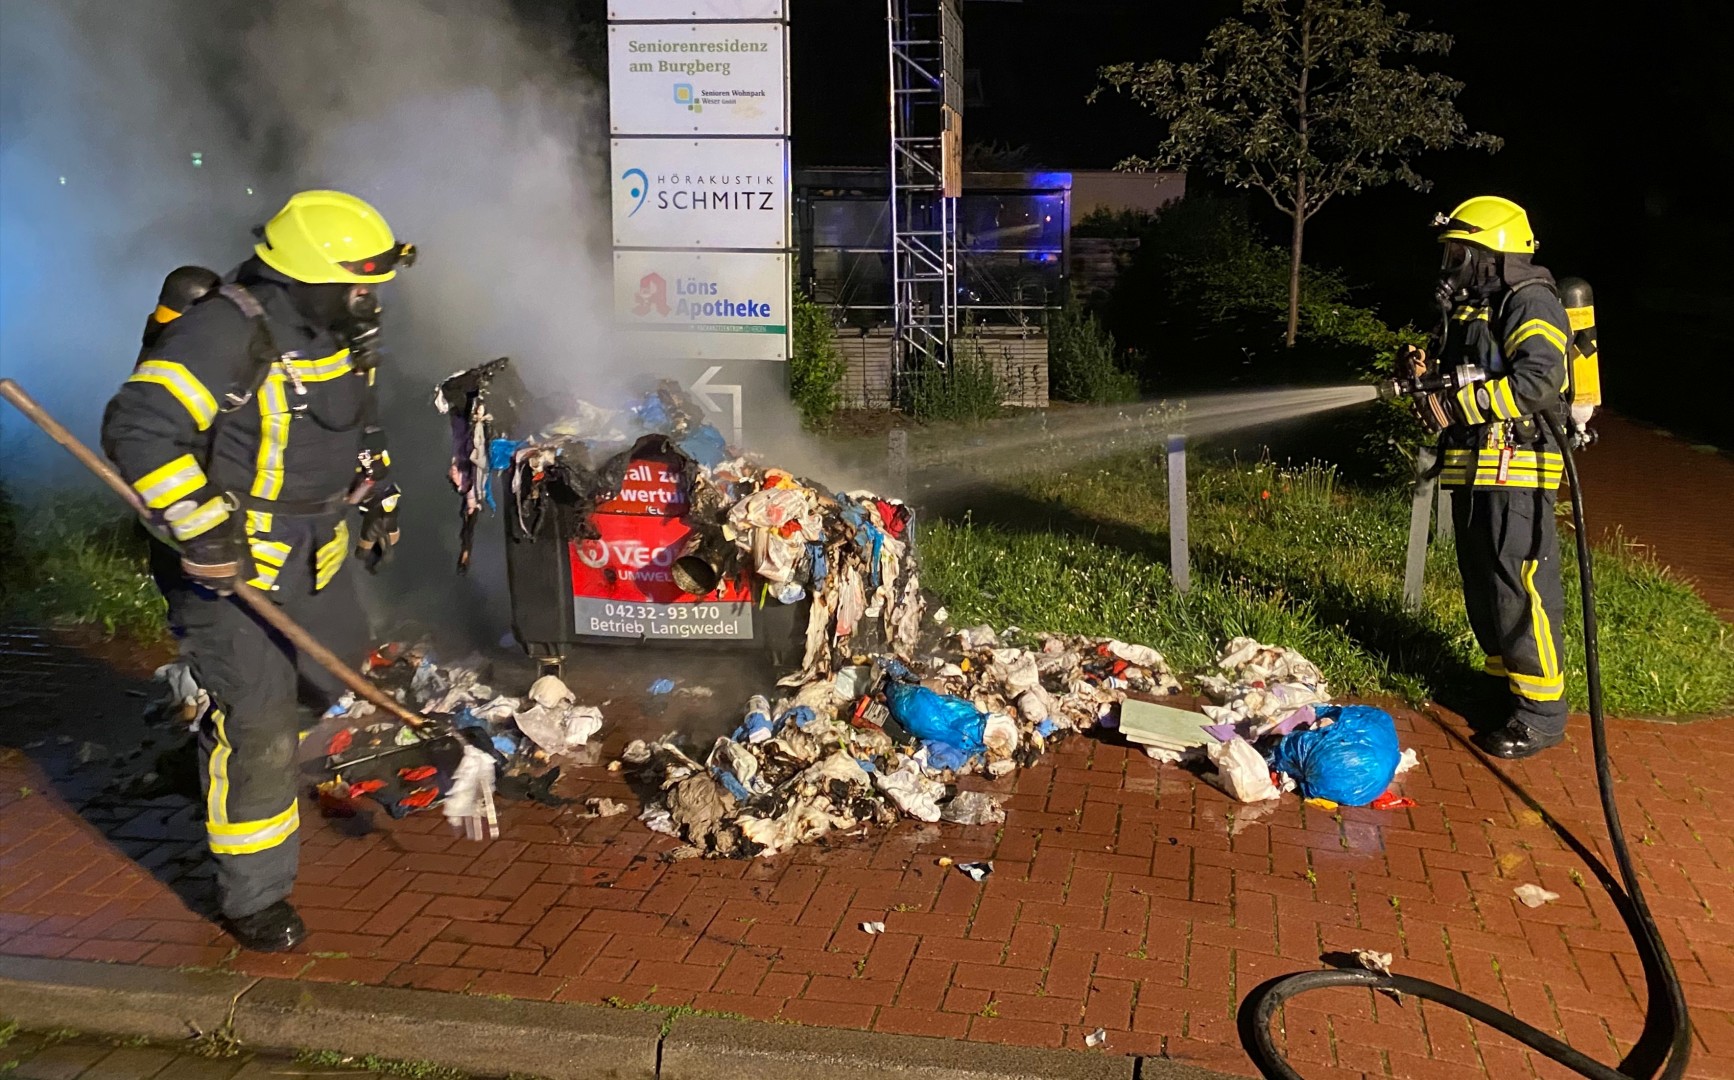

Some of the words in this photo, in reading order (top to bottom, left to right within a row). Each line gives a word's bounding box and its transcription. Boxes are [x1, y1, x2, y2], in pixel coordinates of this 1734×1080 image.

[628, 39, 768, 53] Seniorenresidenz
[629, 62, 653, 73] am
[658, 59, 731, 76] Burgberg
[701, 89, 730, 97] Senioren
[731, 89, 766, 98] Wohnpark
[657, 174, 774, 185] HÖRAKUSTIK
[657, 191, 774, 210] SCHMITZ
[676, 278, 718, 296] Löns
[675, 299, 771, 320] Apotheke
[623, 465, 653, 482] all
[590, 617, 645, 634] Betrieb
[651, 620, 739, 638] Langwedel
